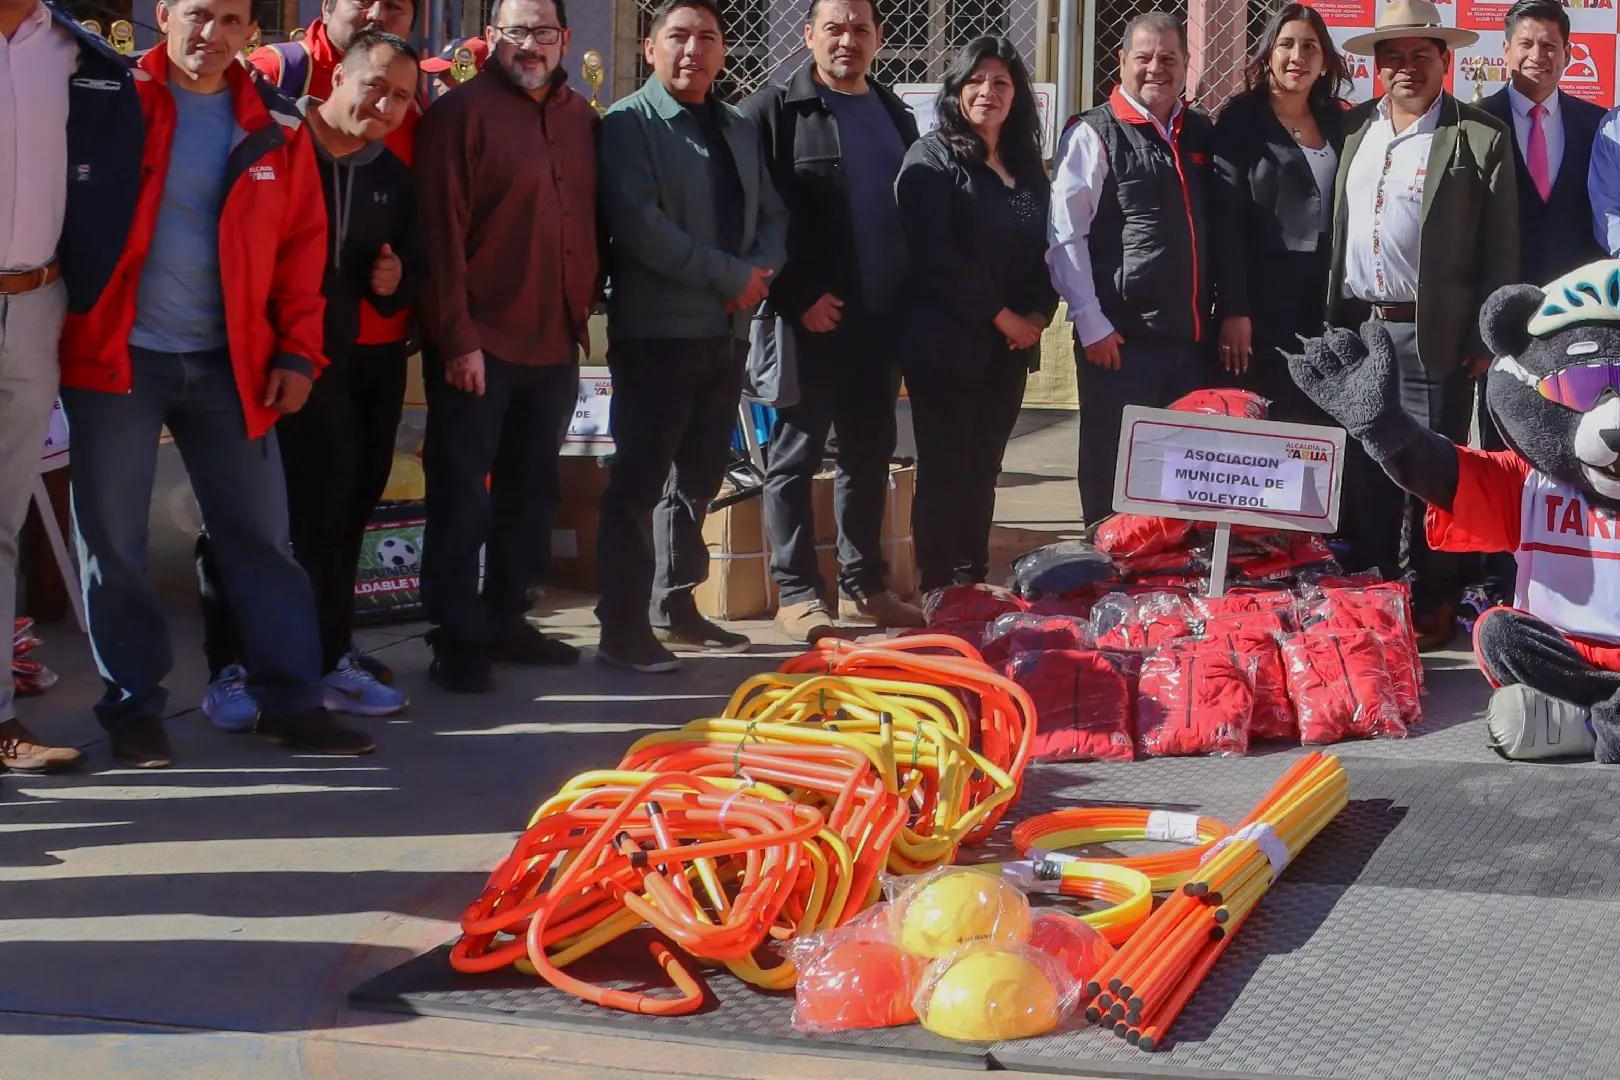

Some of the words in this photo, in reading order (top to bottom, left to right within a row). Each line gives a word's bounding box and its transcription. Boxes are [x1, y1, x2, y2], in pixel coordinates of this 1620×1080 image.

[575, 410, 590, 419] DE
[1184, 449, 1279, 469] ASOCIACION
[1175, 468, 1260, 488] MUNICIPAL
[1264, 478, 1285, 489] DE
[1187, 490, 1268, 508] VOLEYBOL
[354, 579, 409, 594] LDABLE
